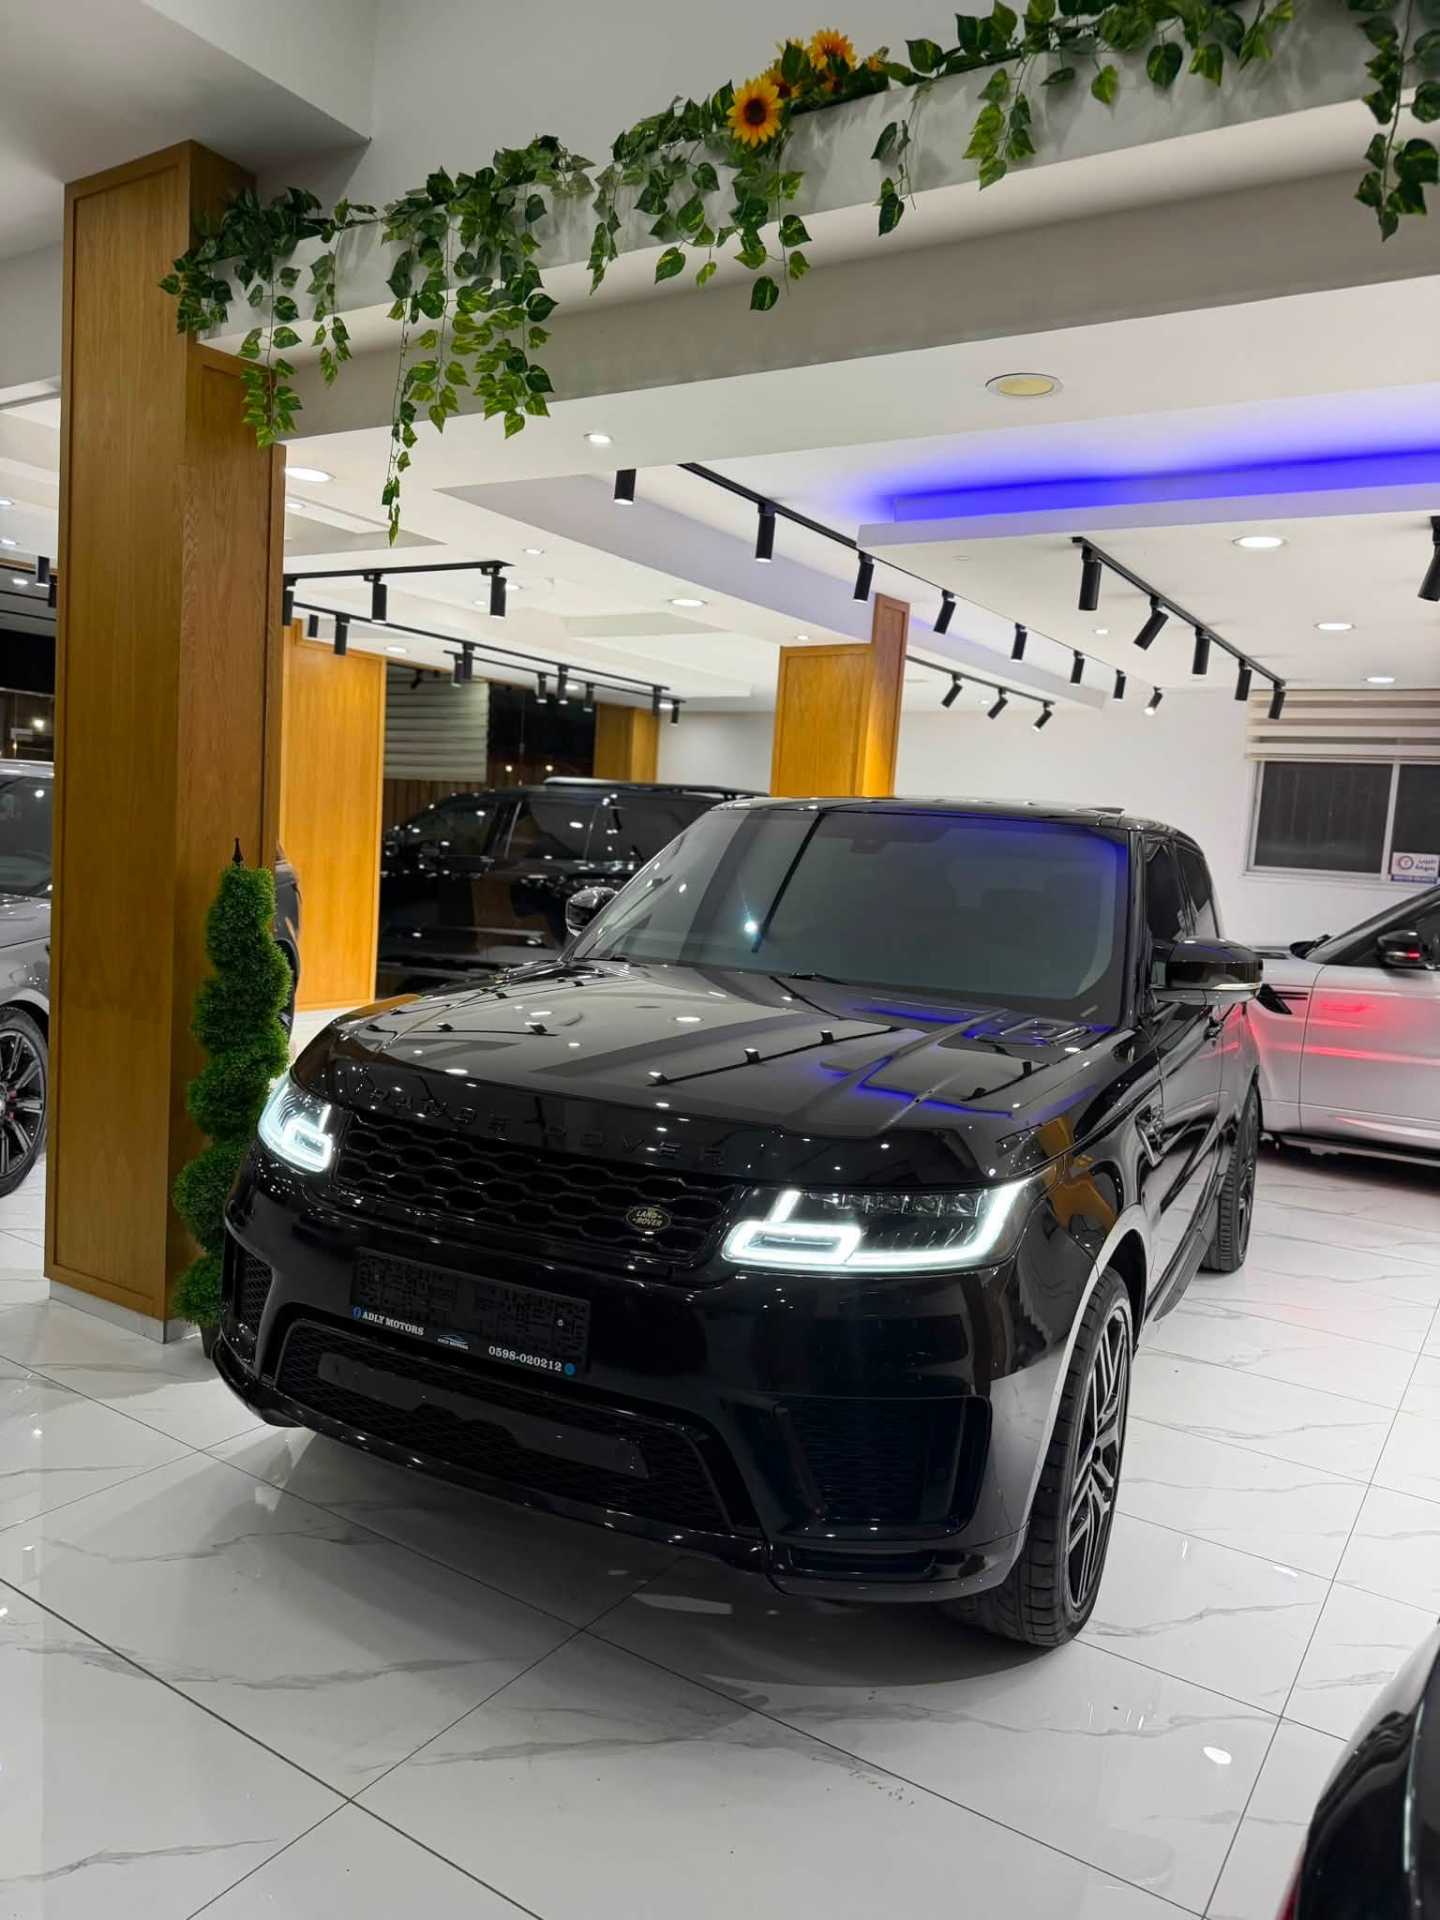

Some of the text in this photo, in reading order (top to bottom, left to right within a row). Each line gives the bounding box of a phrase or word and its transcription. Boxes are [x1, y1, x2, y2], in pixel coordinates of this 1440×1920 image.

[635, 1217, 663, 1227] ROVER
[636, 1207, 658, 1219] LAND
[362, 1311, 425, 1336] ADLY MOTORS
[488, 1345, 562, 1372] 0598-020212
